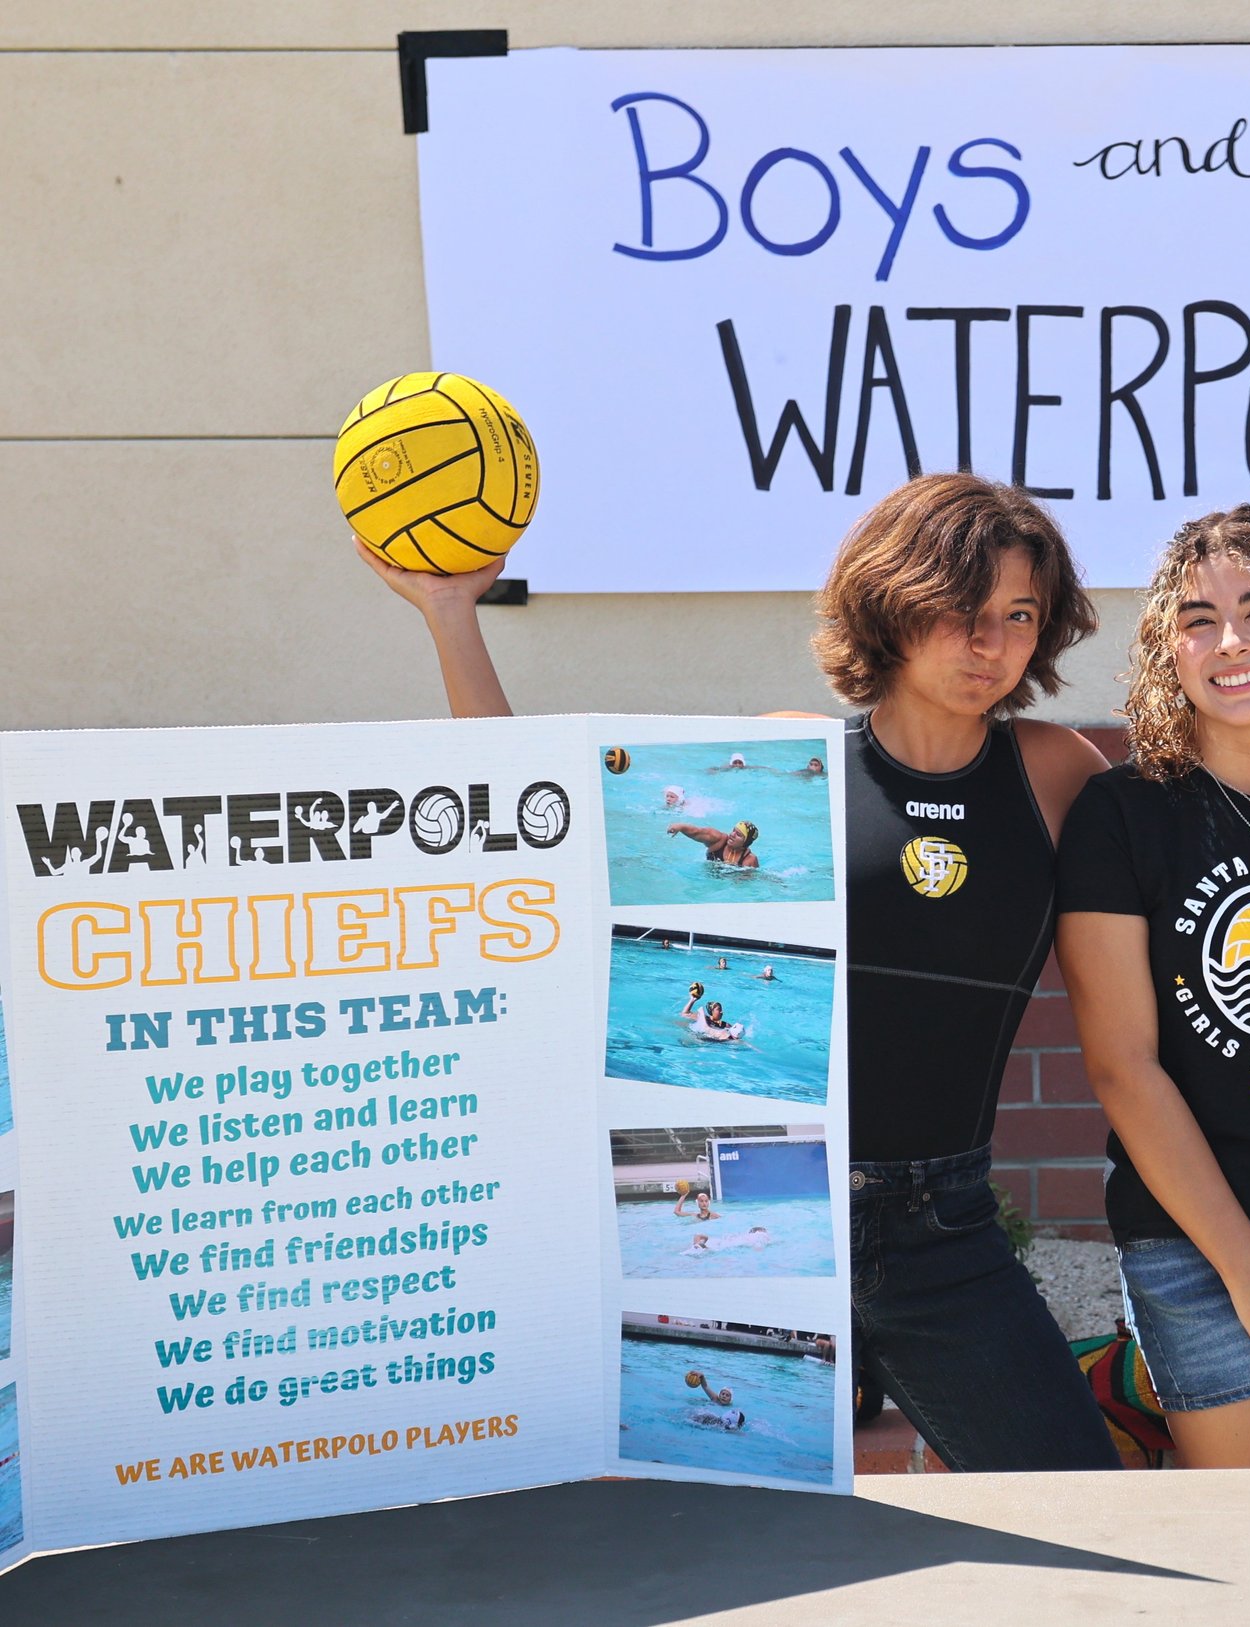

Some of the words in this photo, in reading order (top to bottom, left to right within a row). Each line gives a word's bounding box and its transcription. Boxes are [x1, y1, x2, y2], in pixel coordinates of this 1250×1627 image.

[611, 92, 1031, 282] Boys
[479, 408, 502, 454] HydroGrip
[523, 454, 532, 499] SEVEN
[16, 780, 571, 877] WATERPOLO
[906, 800, 965, 820] arena
[1175, 856, 1249, 935] SANTA
[37, 878, 561, 991] CHIEFS
[106, 1011, 172, 1051] IN
[187, 1002, 326, 1043] THIS
[340, 987, 508, 1034] TEAM:
[1175, 988, 1240, 1058] GIRLS
[146, 1071, 204, 1105] We
[216, 1062, 292, 1105] play
[301, 1050, 460, 1093] together
[129, 1119, 189, 1153] We
[199, 1109, 303, 1145] listen
[313, 1099, 377, 1132] and
[389, 1089, 478, 1126] learn
[132, 1161, 192, 1194] We
[202, 1150, 280, 1187] help
[289, 1140, 370, 1175] each
[381, 1130, 478, 1164] other
[720, 1151, 739, 1160] anti
[113, 1211, 163, 1240] We
[171, 1205, 254, 1235] learn
[261, 1195, 338, 1225] from
[345, 1185, 413, 1215] each
[420, 1178, 501, 1208] other
[131, 1249, 190, 1281] We
[200, 1238, 275, 1274] find
[285, 1220, 489, 1264] friendships
[168, 1290, 227, 1322] We
[236, 1278, 312, 1313] find
[322, 1265, 456, 1306] respect
[154, 1335, 213, 1368] We
[222, 1324, 297, 1361] find
[307, 1306, 497, 1352] motivation
[156, 1382, 215, 1415] We
[224, 1375, 269, 1405] do
[278, 1364, 377, 1407] great
[385, 1351, 496, 1390] things
[115, 1458, 162, 1486] WE
[168, 1450, 225, 1480] ARE
[231, 1429, 399, 1473] WATERPOLO
[405, 1414, 519, 1451] PLAYERS
